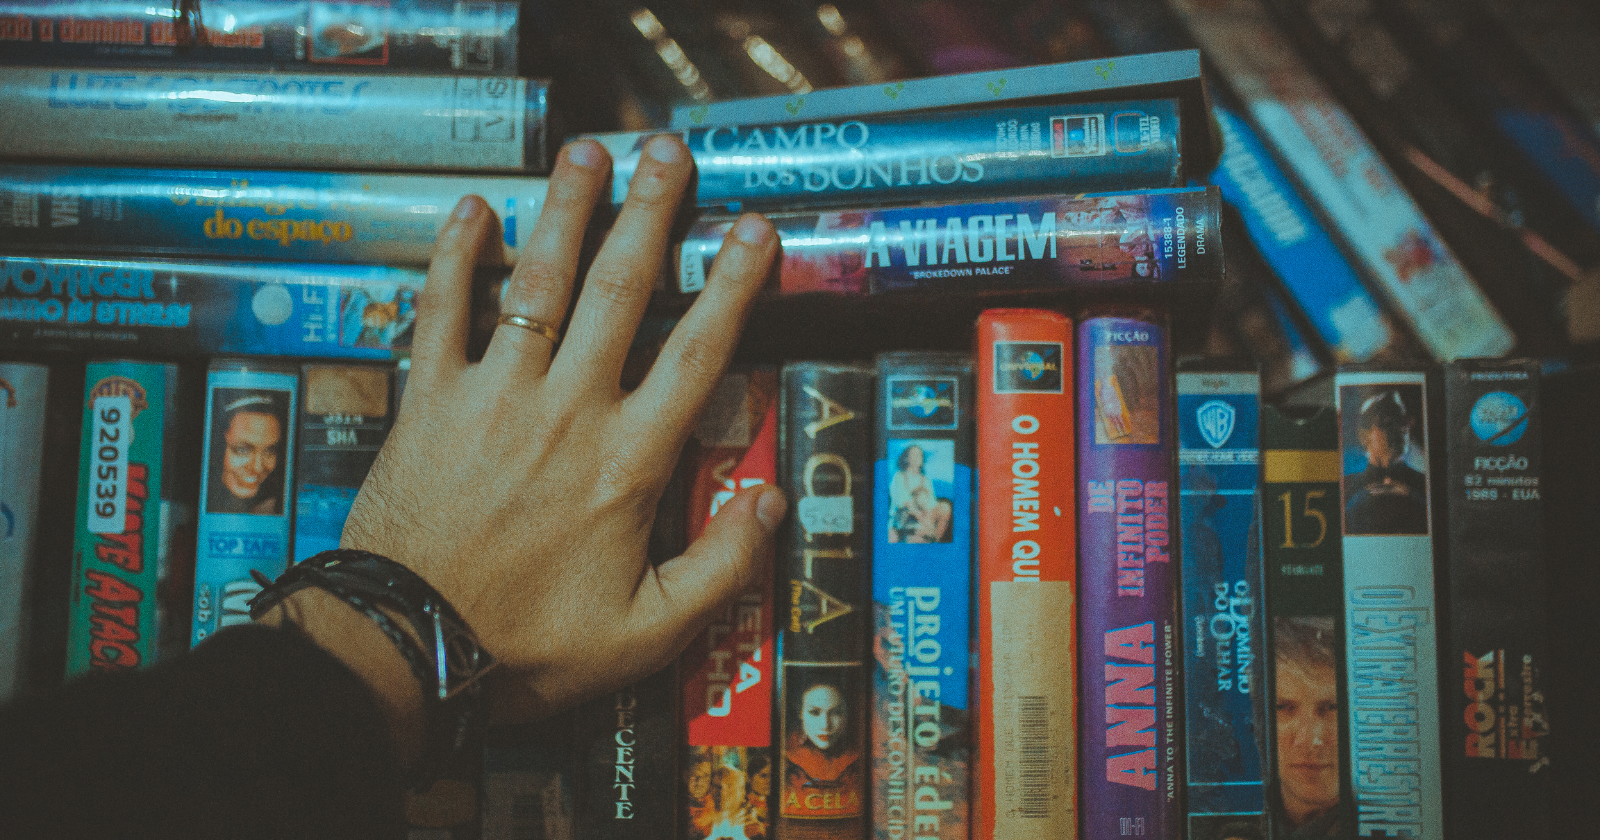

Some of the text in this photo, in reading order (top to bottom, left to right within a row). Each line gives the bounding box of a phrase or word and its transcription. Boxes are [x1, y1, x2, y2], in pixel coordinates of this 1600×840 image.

[703, 120, 870, 156] CAMPO
[802, 152, 986, 192] SONHOS
[51, 190, 80, 228] VH
[203, 209, 243, 240] do
[246, 217, 354, 247] espaço
[864, 211, 1057, 268] A VIAGEM
[1163, 216, 1174, 260] 15388-1
[1175, 205, 1187, 270] LEGENDADO
[1195, 216, 1206, 255] DRAMA
[1106, 329, 1150, 345] FICÇÃO
[1011, 414, 1040, 435] O
[95, 406, 122, 521] 920539
[1474, 453, 1529, 472] FICÇÃO
[1011, 442, 1040, 533] HOMEM
[1087, 478, 1116, 514] DE
[1512, 488, 1540, 501] EUA
[802, 385, 855, 634] A CLA
[1144, 480, 1170, 564] PODER
[1278, 489, 1328, 549] 15
[1115, 477, 1146, 598] INFINITO
[1209, 581, 1237, 692] DO OLHAR
[1104, 620, 1157, 792] ANNA
[1164, 669, 1174, 719] INFINITE
[1463, 650, 1496, 759] ROCK
[1165, 721, 1174, 743] THE
[1165, 747, 1174, 762] TO
[786, 791, 859, 810] A CELA
